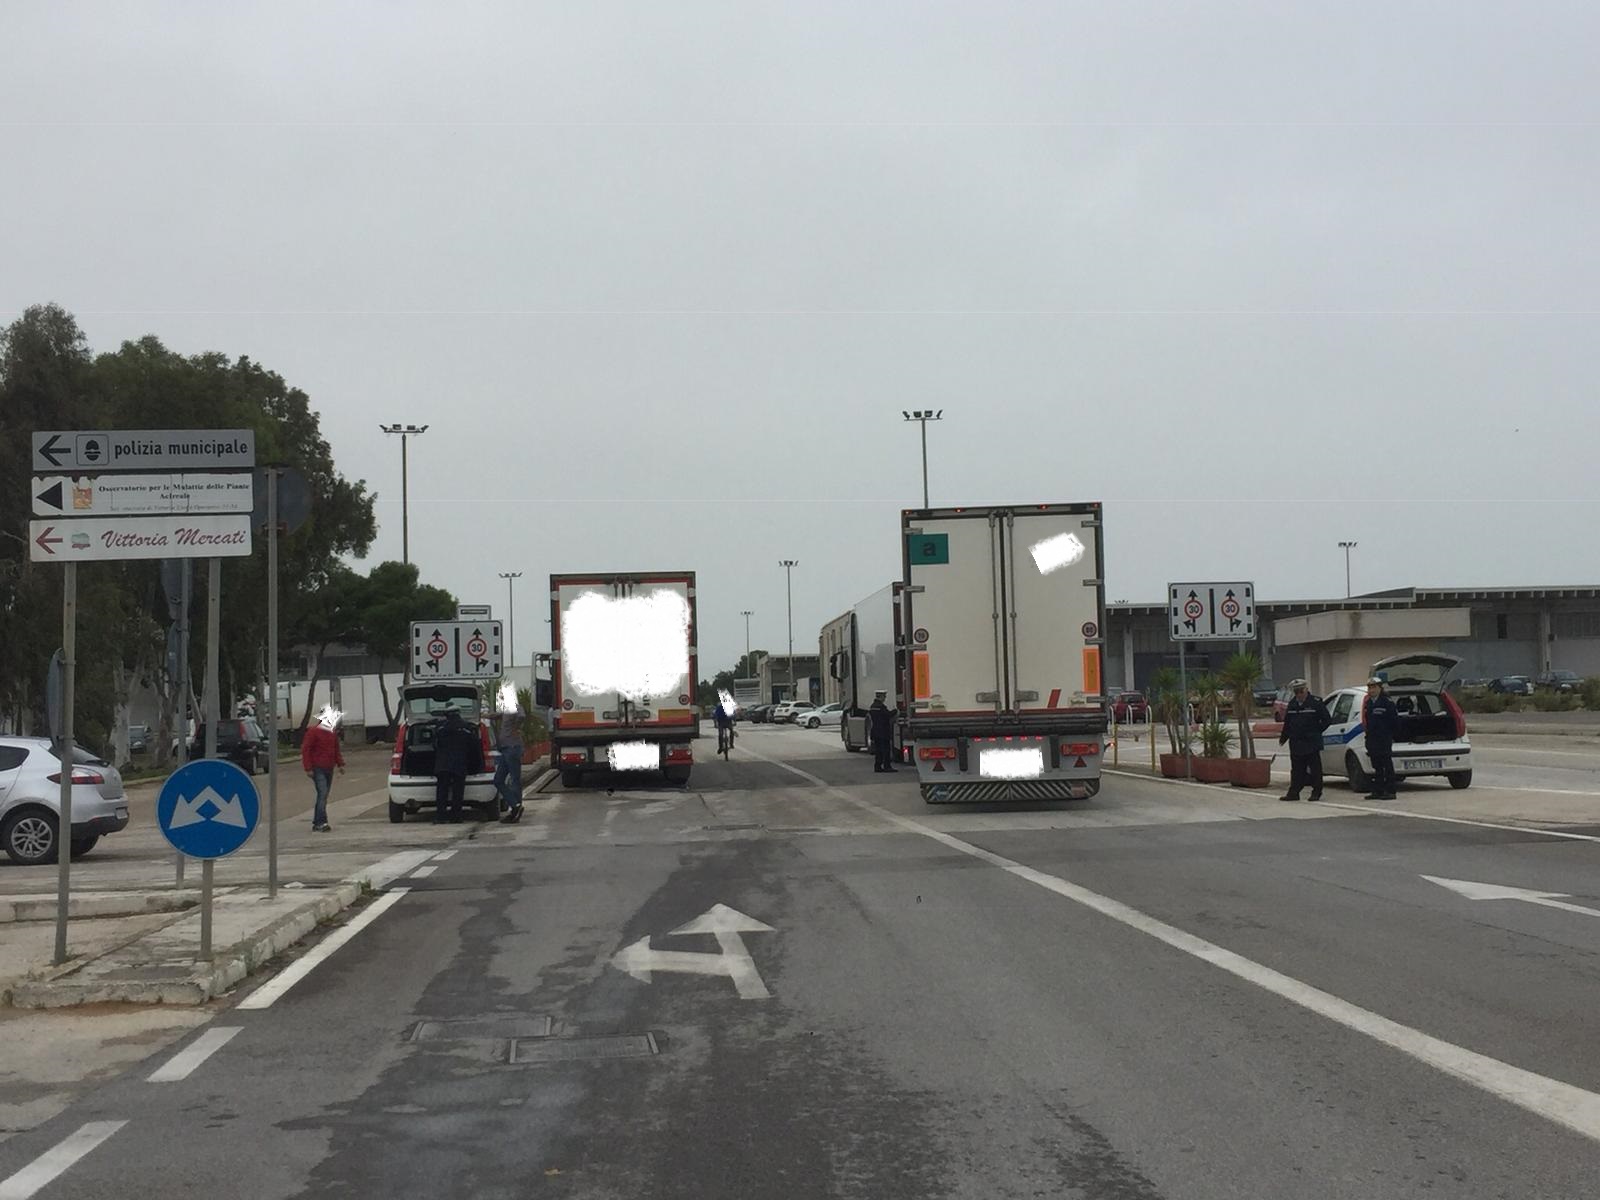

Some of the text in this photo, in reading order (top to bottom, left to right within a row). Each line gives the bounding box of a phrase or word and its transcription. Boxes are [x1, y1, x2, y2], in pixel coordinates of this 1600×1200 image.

[114, 439, 248, 459] polizia municipale
[98, 485, 146, 493] Osservatorio
[149, 485, 161, 493] per
[173, 483, 204, 491] Malattie
[101, 527, 246, 548] Vittoria Mercati
[922, 542, 937, 557] a
[1188, 604, 1199, 614] 30
[1225, 604, 1236, 613] 30
[432, 644, 443, 653] 30
[471, 643, 483, 653] 30
